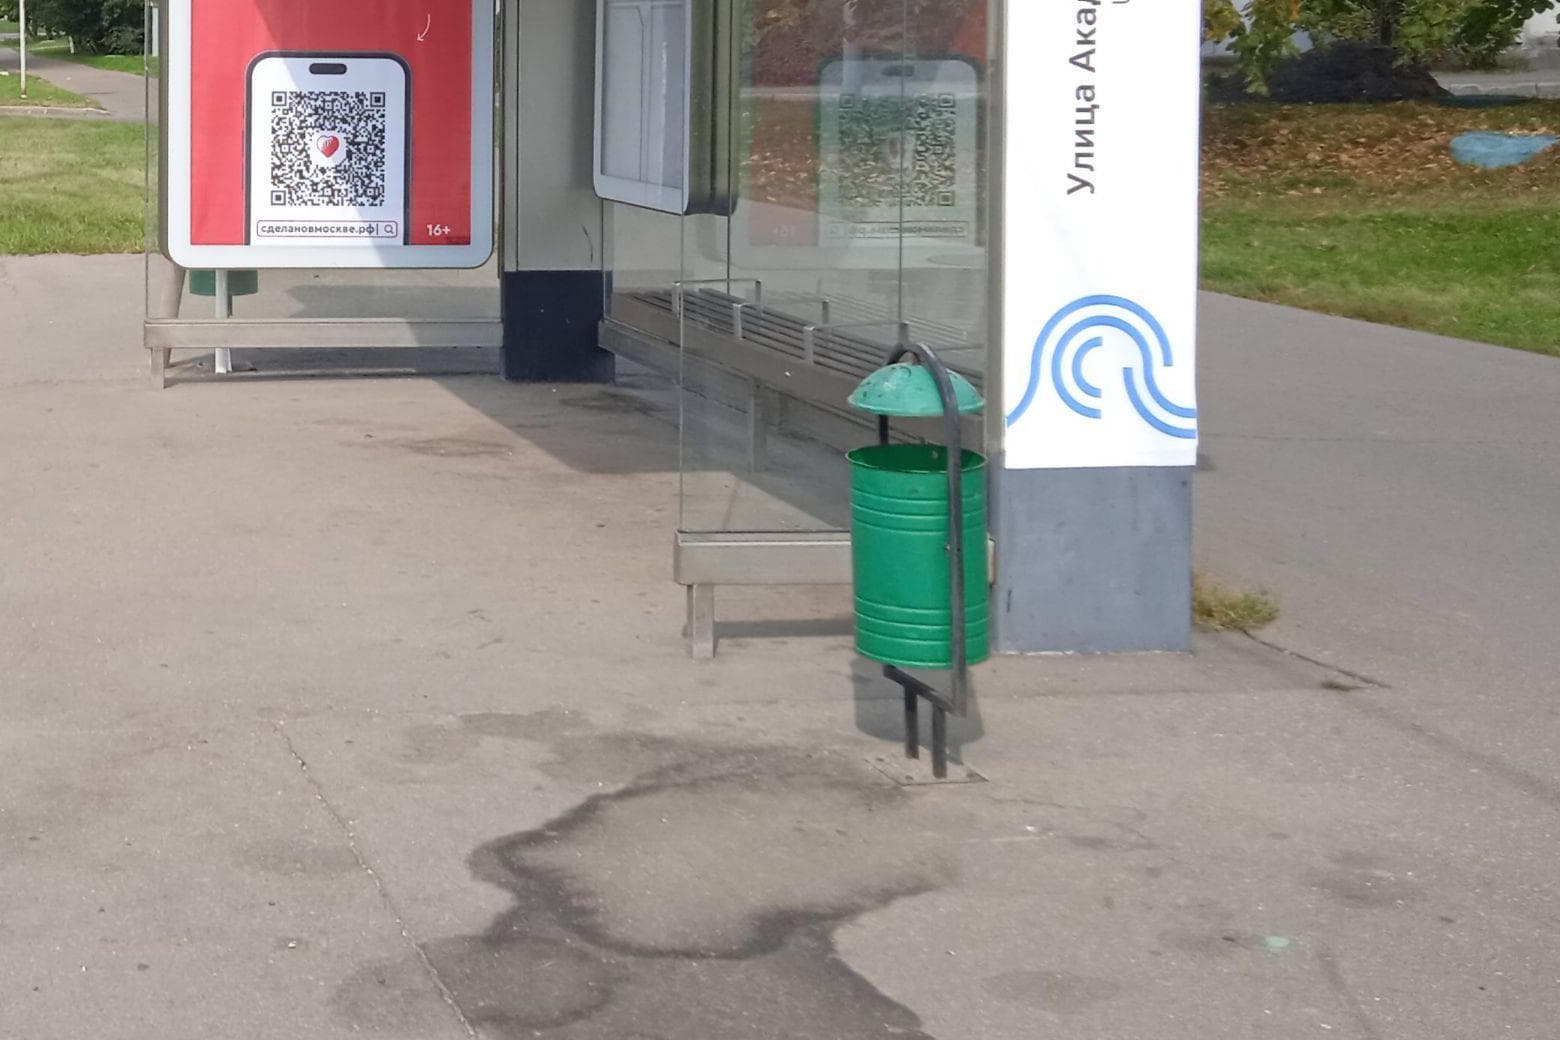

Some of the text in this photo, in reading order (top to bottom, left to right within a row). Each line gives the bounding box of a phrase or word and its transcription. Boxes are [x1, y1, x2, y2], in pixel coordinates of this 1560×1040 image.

[1066, 85, 1100, 196] Улица
[261, 223, 375, 236] сделановмоскве.рф
[426, 223, 451, 236] 16+
